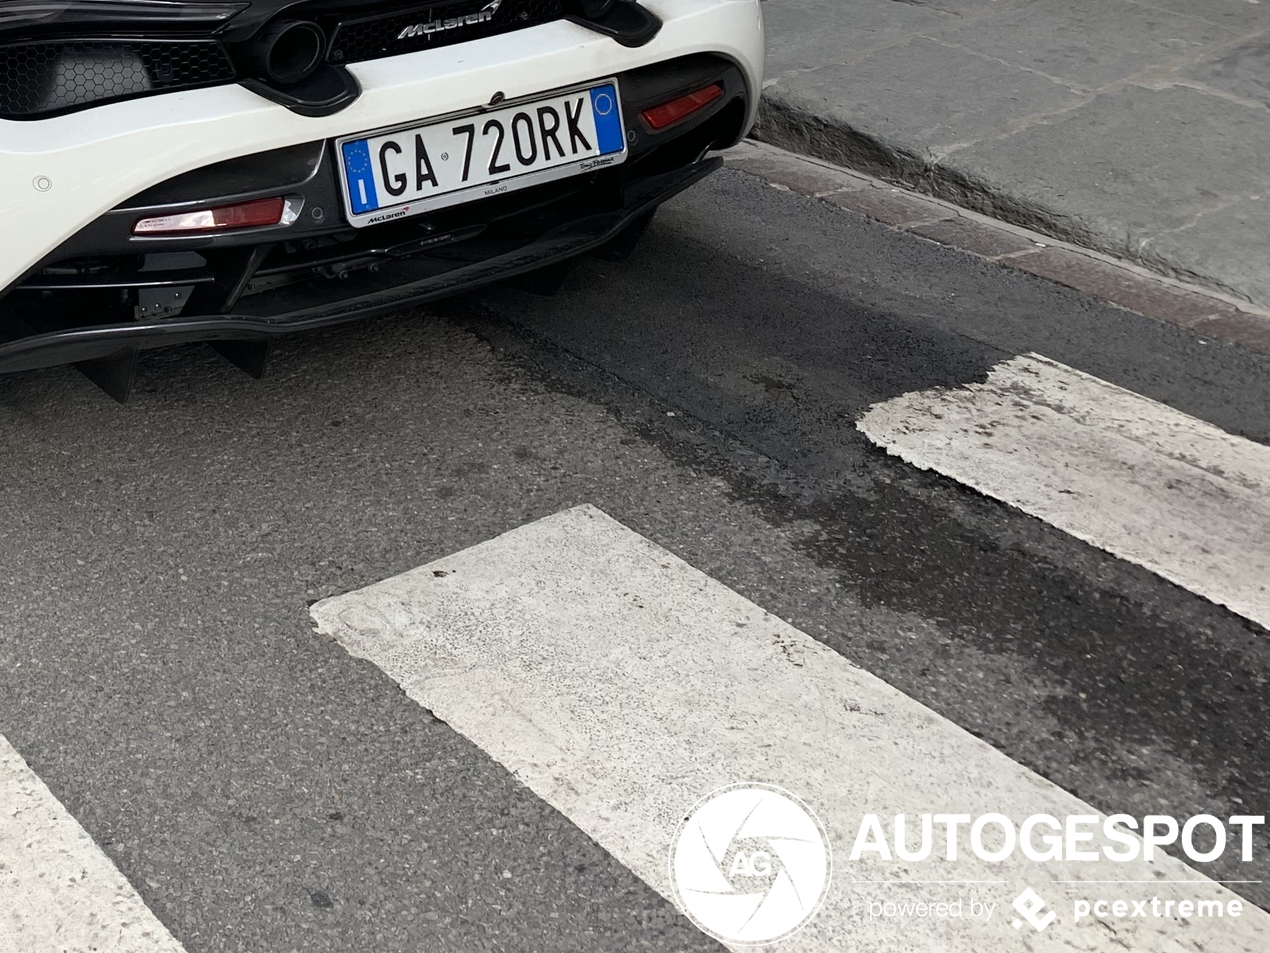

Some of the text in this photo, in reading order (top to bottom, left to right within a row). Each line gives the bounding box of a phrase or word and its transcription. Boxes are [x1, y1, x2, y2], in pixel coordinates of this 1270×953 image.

[397, 9, 493, 39] McLaren
[379, 134, 439, 197] GA
[452, 97, 592, 182] 720RK
[484, 185, 508, 196] MILANO
[367, 210, 407, 224] McLaren
